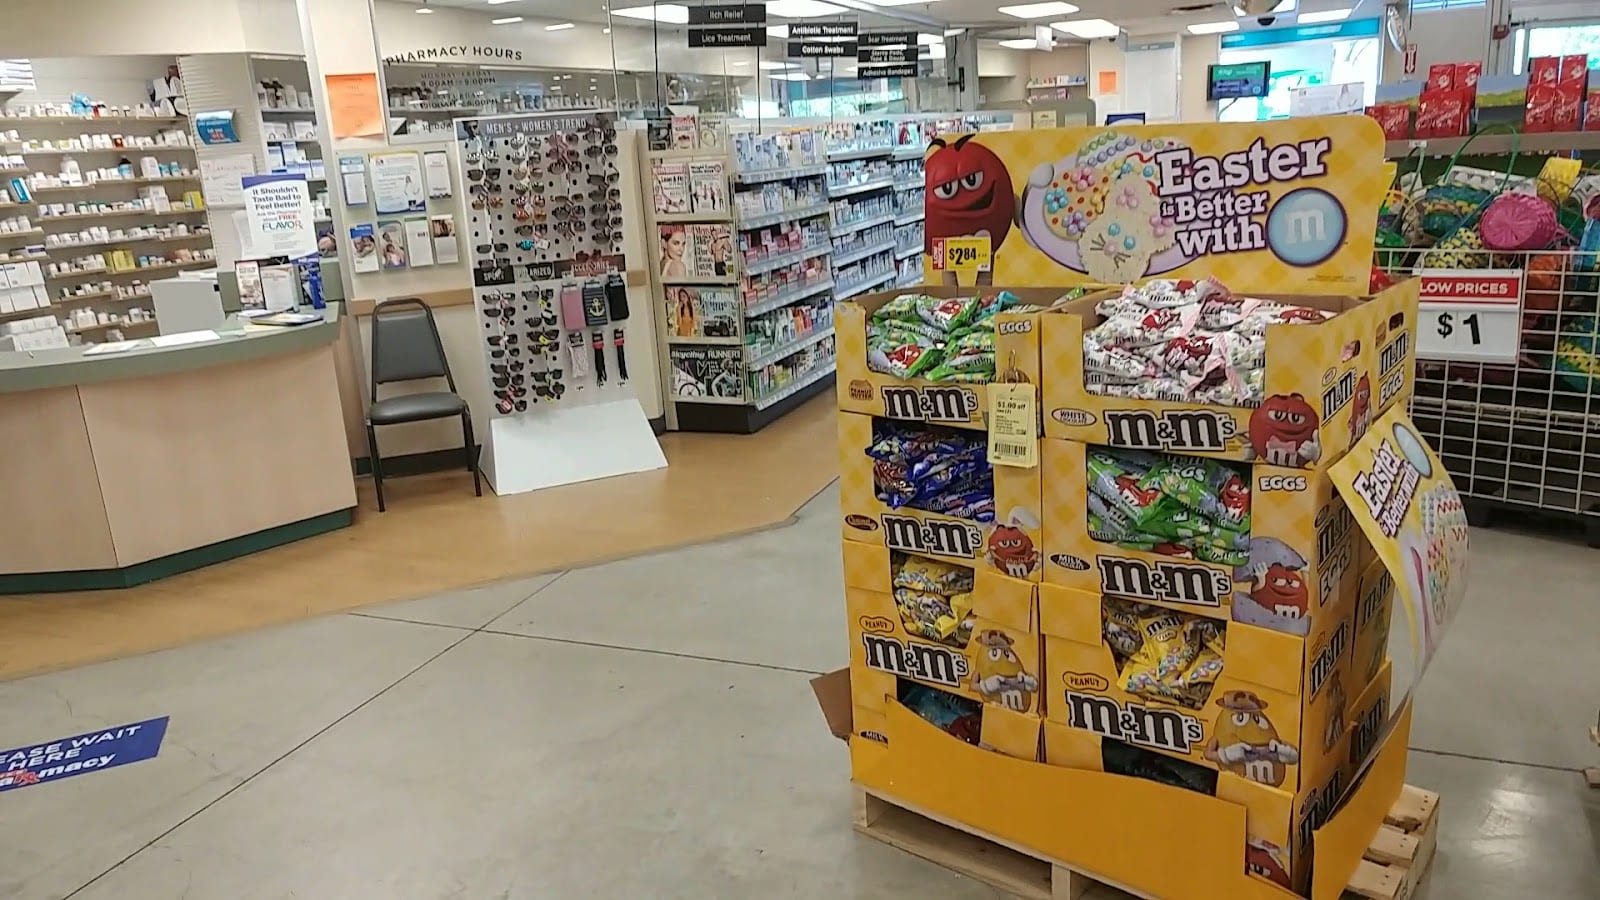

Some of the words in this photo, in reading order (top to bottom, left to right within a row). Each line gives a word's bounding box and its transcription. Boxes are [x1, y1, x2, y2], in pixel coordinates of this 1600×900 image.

[724, 9, 744, 19] Relief
[792, 24, 821, 34] Antibiotic
[823, 26, 854, 34] Treatment
[702, 34, 716, 43] Lice
[717, 33, 752, 42] Treatment
[385, 46, 467, 67] PHARMACY
[473, 46, 522, 61] HOURS
[802, 46, 823, 54] Cotton
[486, 122, 513, 135] MEN'S
[521, 119, 559, 133] WOMEN'S
[561, 118, 587, 130] TREND
[1155, 137, 1331, 196] Easter
[252, 188, 259, 196] It
[261, 186, 299, 195] Shouldn't
[1160, 201, 1176, 217] is
[1174, 190, 1269, 223] Better
[1176, 217, 1266, 257] with
[1420, 282, 1452, 294] LOW
[1455, 283, 1509, 295] PRICES
[999, 320, 1032, 335] EGGS
[1060, 410, 1087, 419] WHITE
[1259, 474, 1307, 492] EGGS
[1353, 439, 1404, 519] Easter
[1059, 554, 1081, 566] MILK
[1069, 676, 1100, 688] PEANUT
[72, 725, 142, 748] WAIT
[8, 747, 83, 771] HERE
